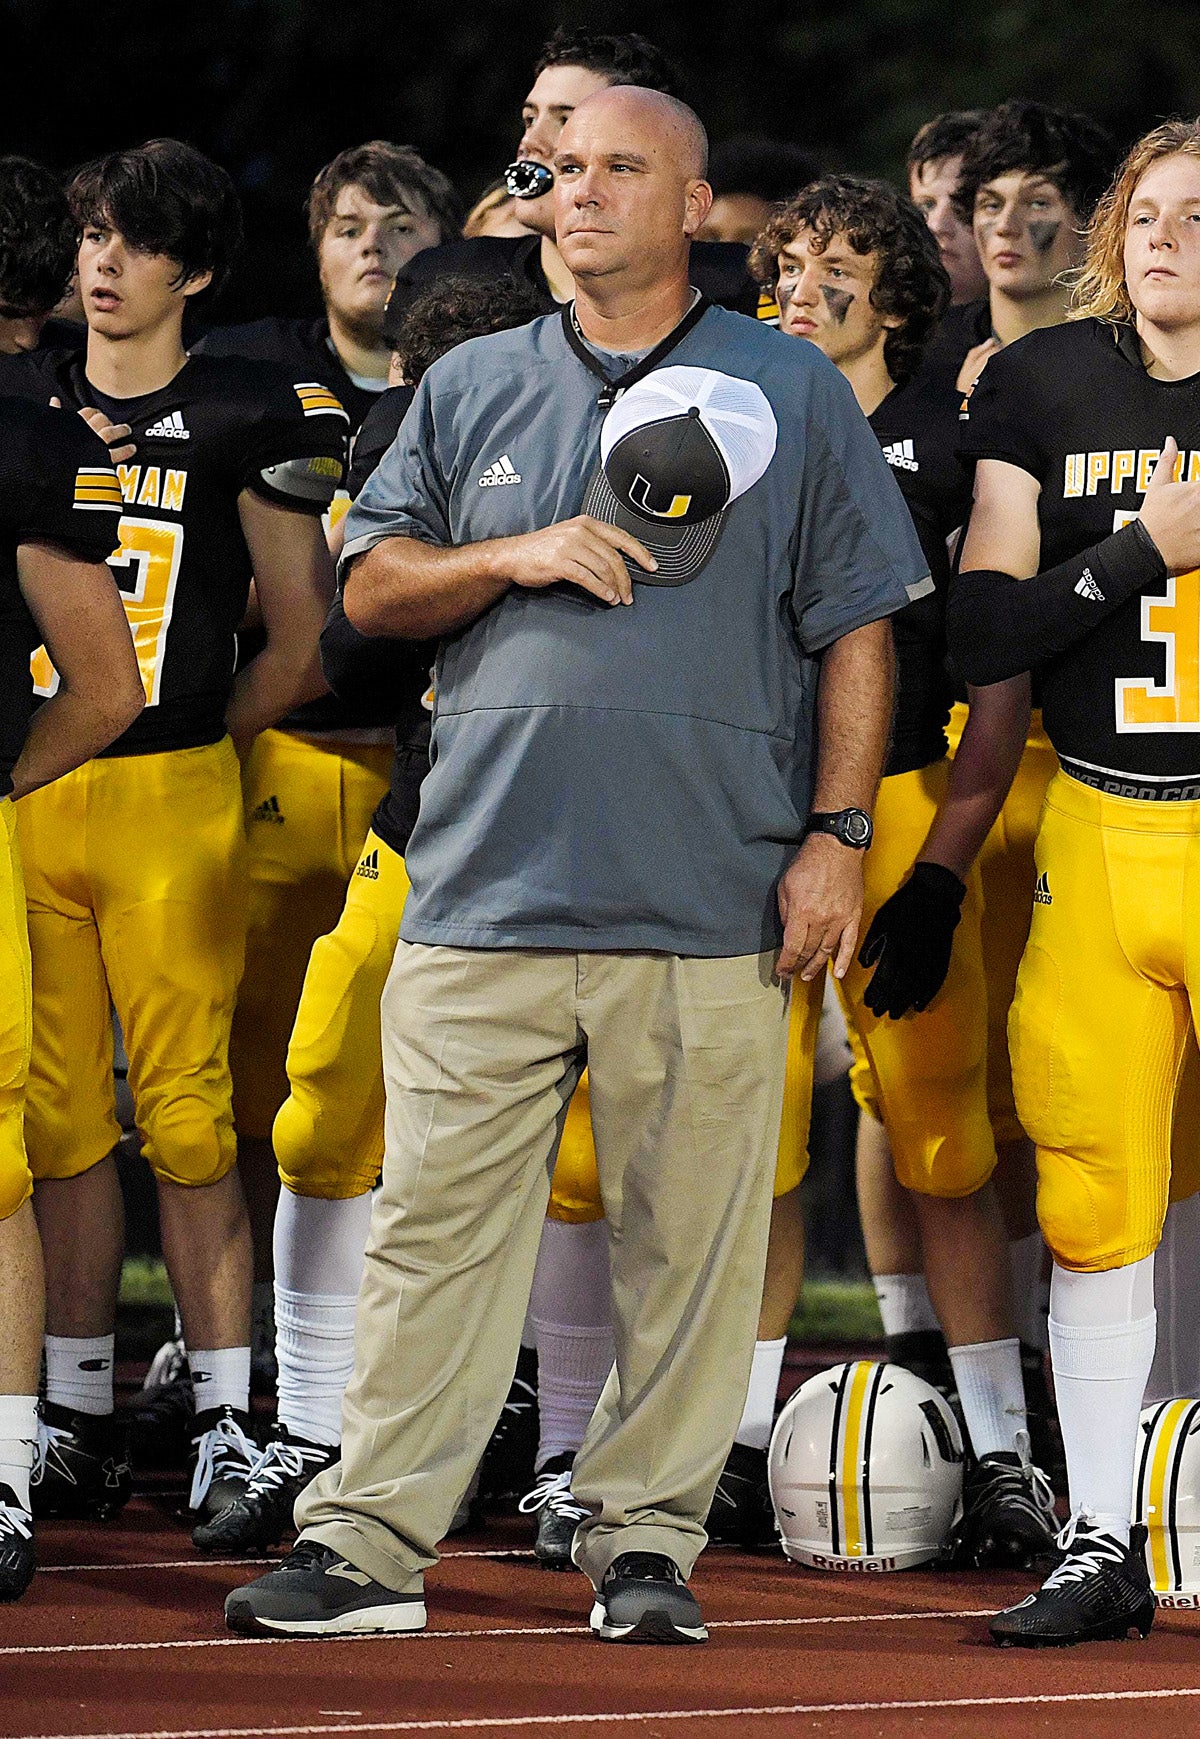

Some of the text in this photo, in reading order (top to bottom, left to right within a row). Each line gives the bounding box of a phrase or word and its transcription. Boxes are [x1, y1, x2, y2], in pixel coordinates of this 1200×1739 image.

[145, 427, 190, 439] adidas
[478, 472, 522, 487] adidas
[628, 473, 692, 518] U
[811, 1554, 896, 1573] Riddell
